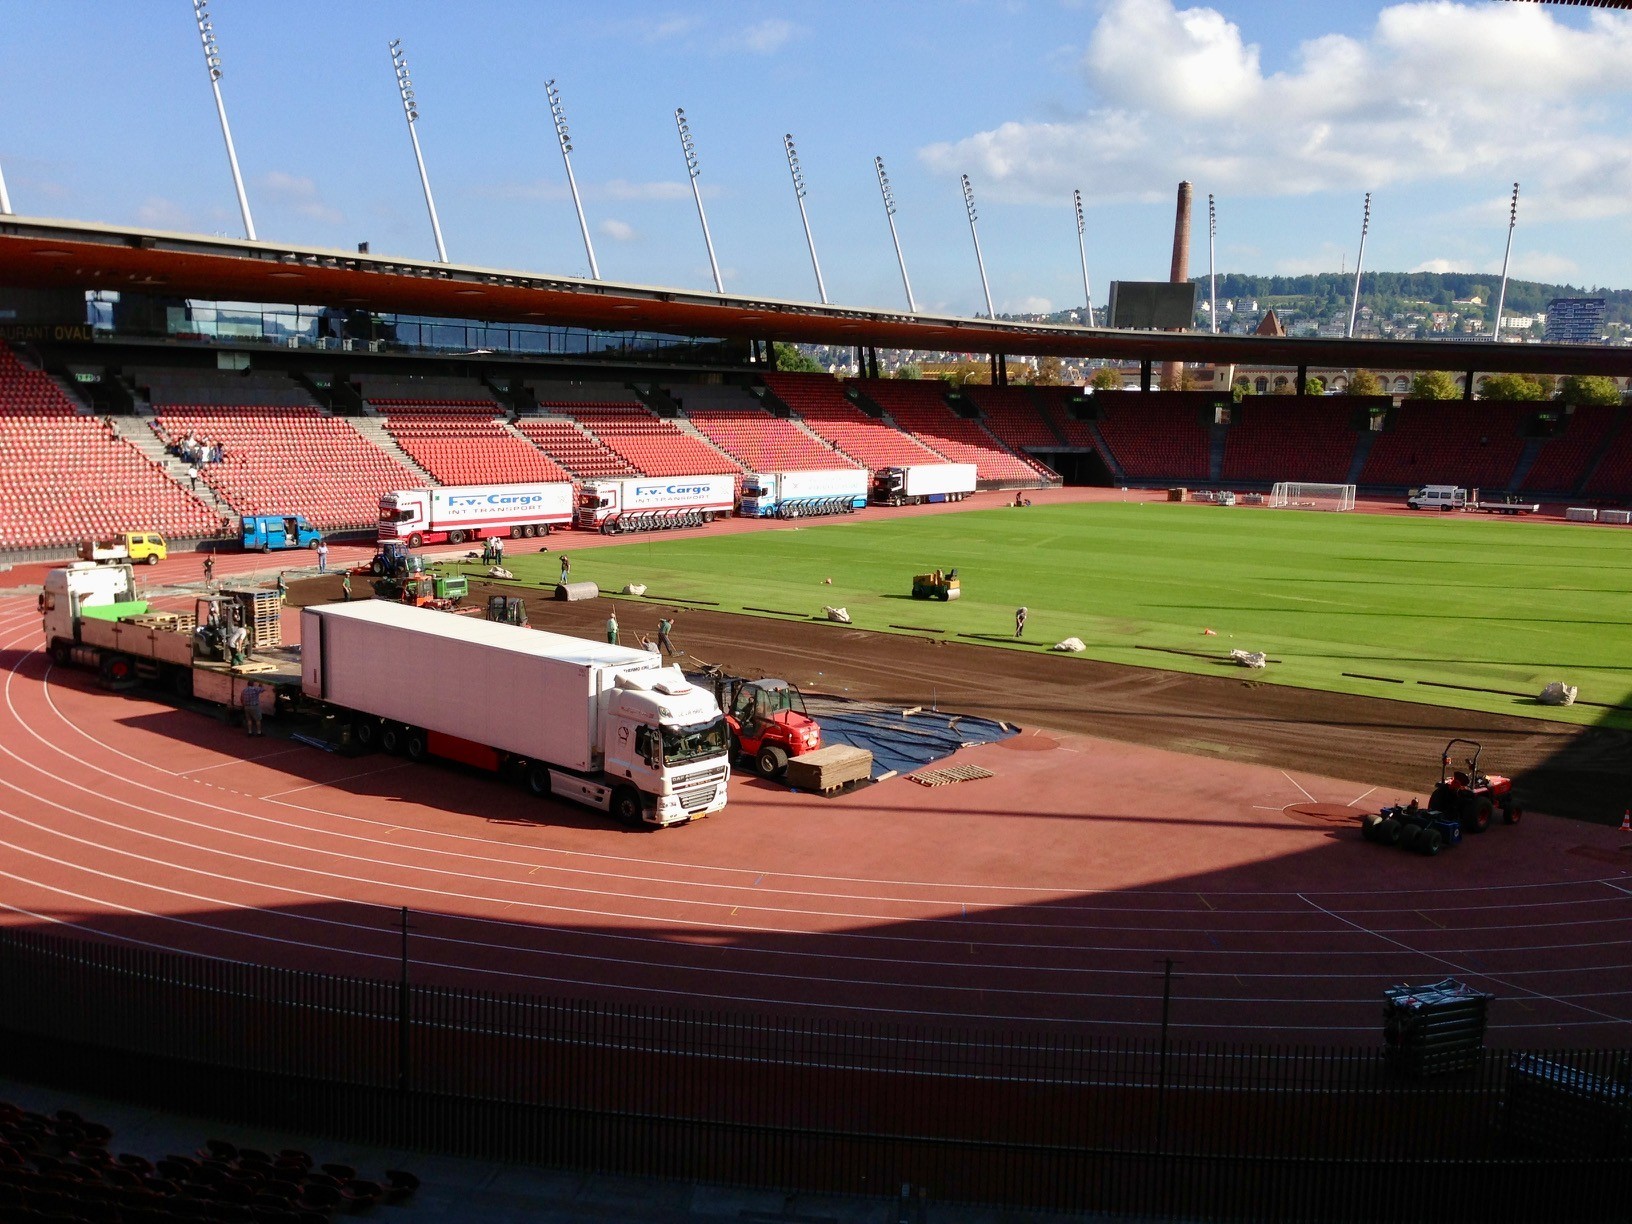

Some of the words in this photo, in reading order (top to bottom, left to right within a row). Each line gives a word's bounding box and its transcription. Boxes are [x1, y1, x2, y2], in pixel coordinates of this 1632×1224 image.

[55, 326, 91, 340] OVAL
[635, 487, 662, 496] F.v.
[666, 485, 710, 494] Cargo
[448, 495, 482, 506] F.v.
[487, 494, 543, 505] Cargo
[655, 494, 709, 502] TRANSPORT
[474, 504, 542, 514] TRANSPORT
